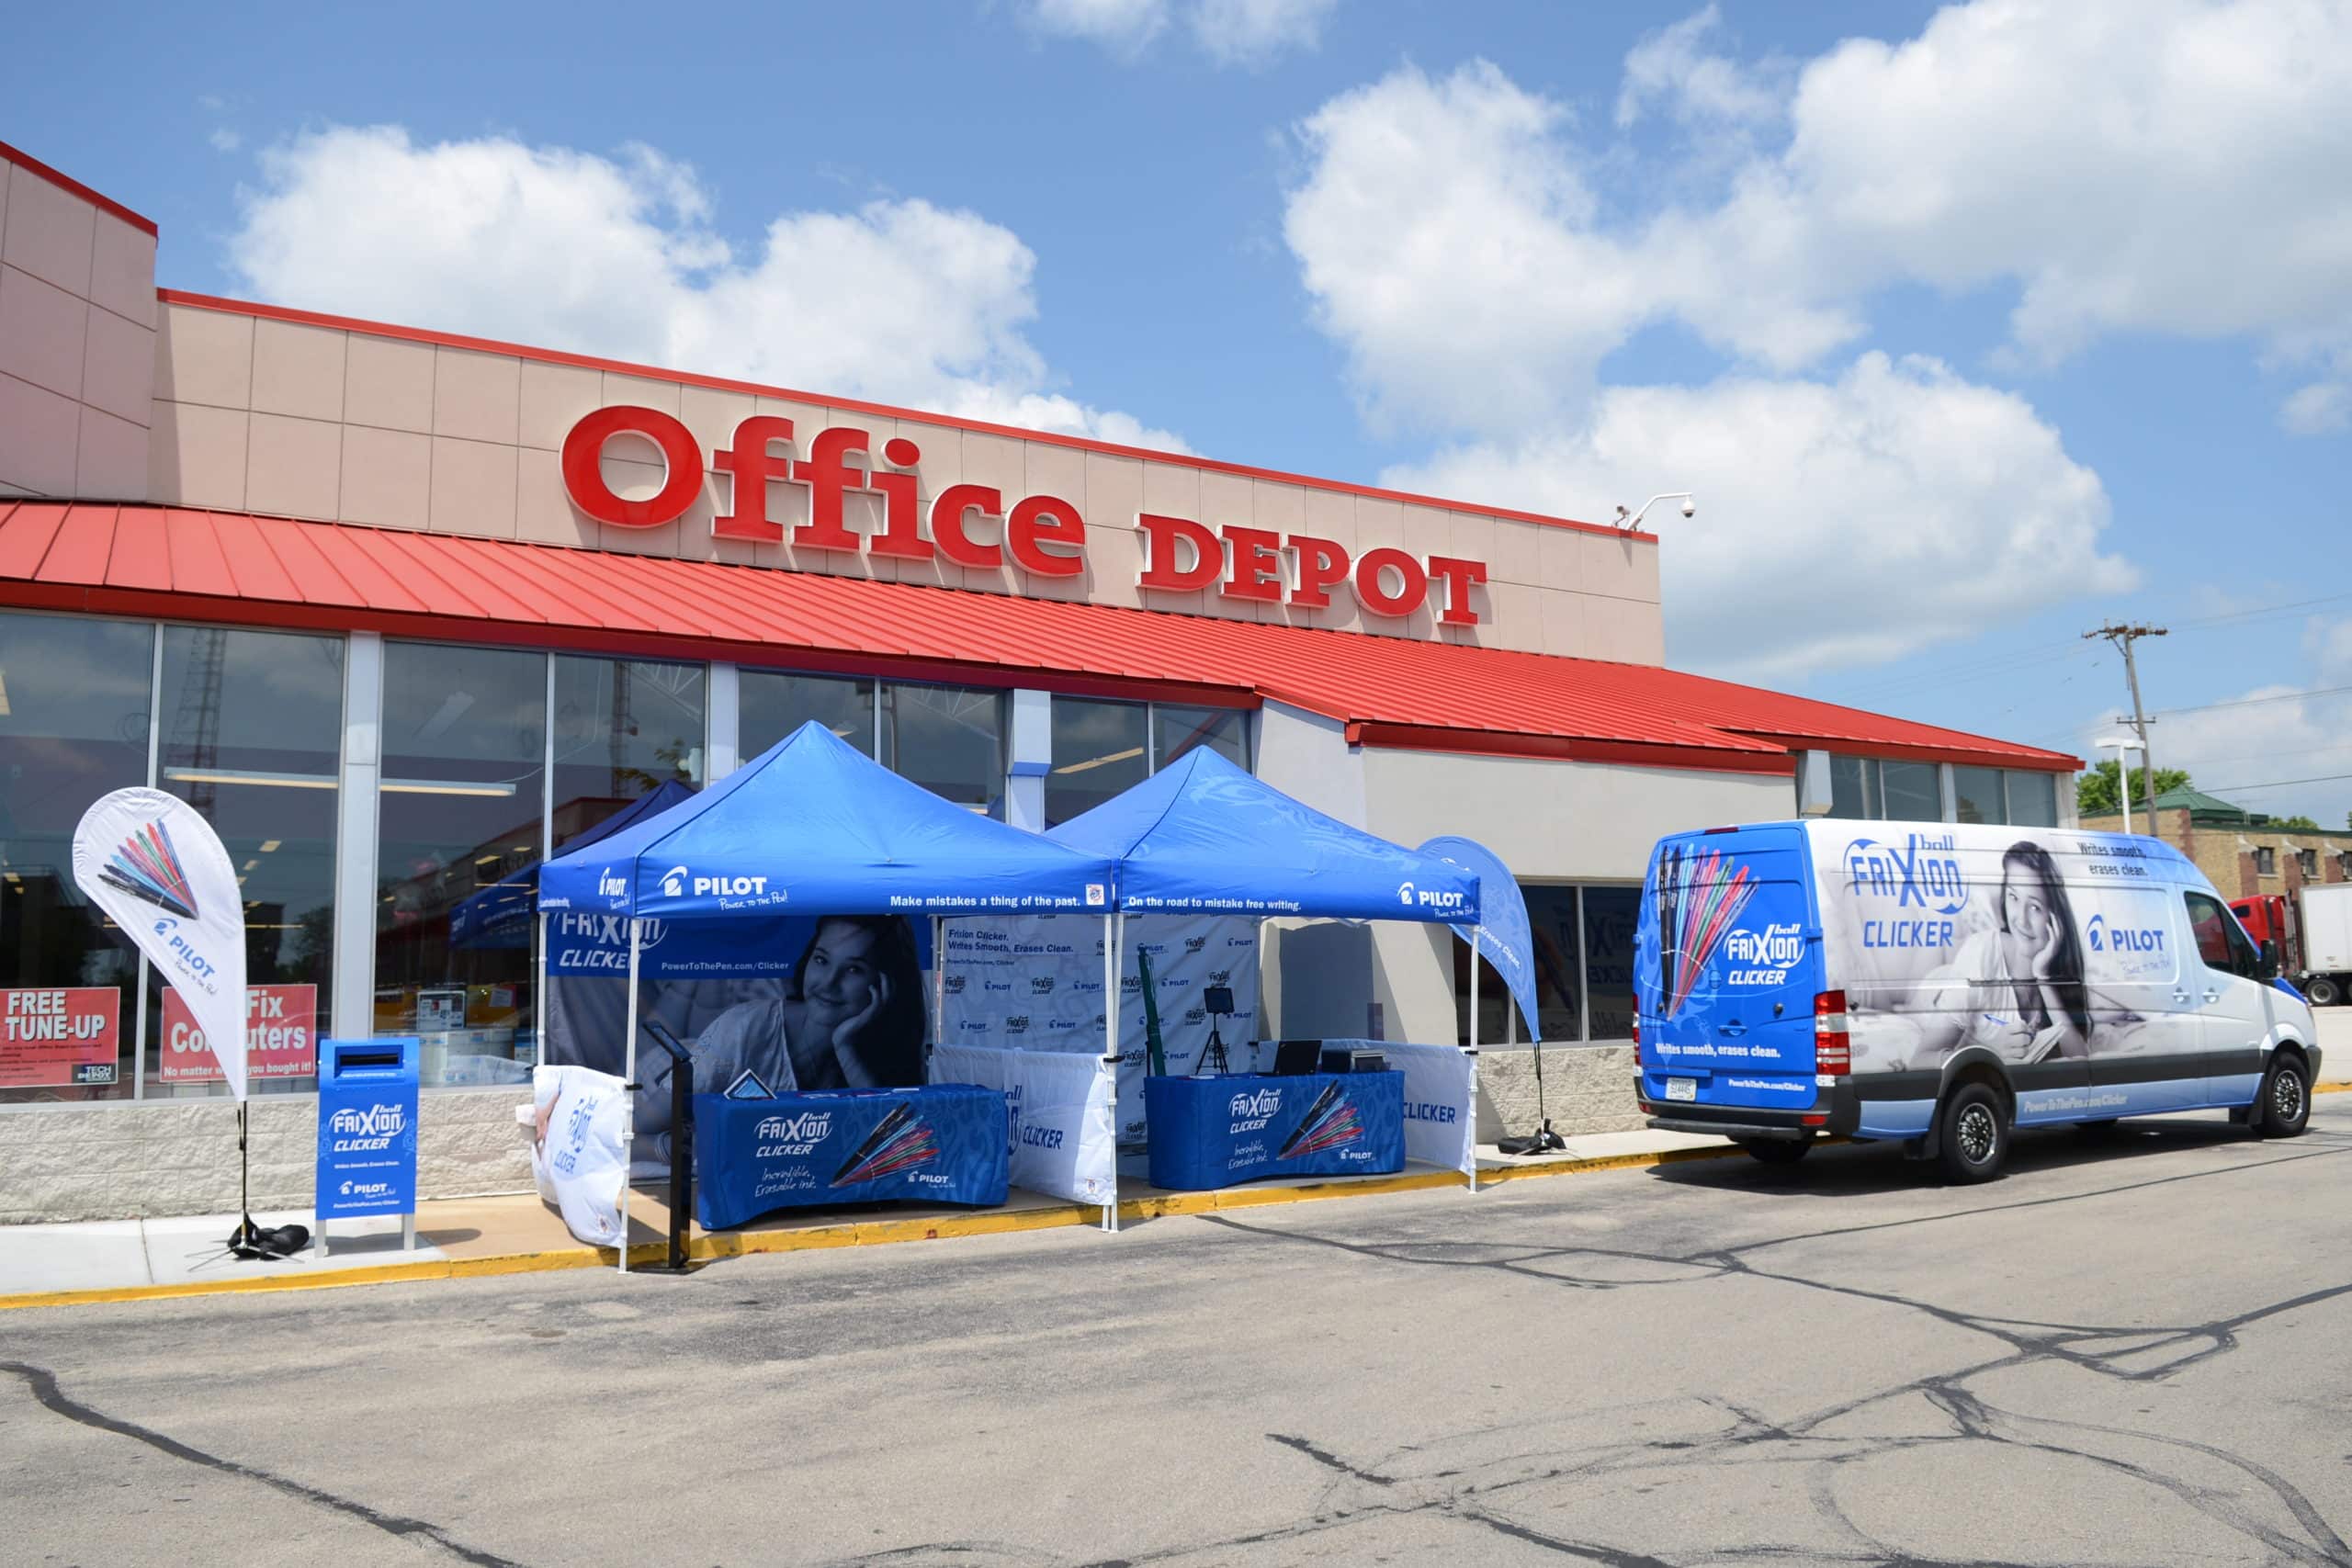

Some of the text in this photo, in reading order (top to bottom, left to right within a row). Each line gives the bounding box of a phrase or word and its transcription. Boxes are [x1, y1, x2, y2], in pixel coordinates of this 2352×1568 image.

[561, 405, 1487, 626] Office DEPOT
[1920, 834, 1954, 851] ball
[2077, 842, 2109, 855] Writes
[2088, 863, 2148, 875] erases clean.
[605, 878, 627, 897] PILOT
[694, 877, 767, 896] PILOT
[890, 896, 1081, 909] Make mistakes a thing of the past.
[1128, 897, 1302, 911] On the road to mistake free writing.
[1419, 891, 1463, 908] PILOT
[1774, 924, 1801, 934] ball
[1863, 921, 1953, 947] CLICKER
[1480, 925, 1502, 949] Erases
[2111, 930, 2164, 951] PILOT
[948, 941, 1074, 953] Writes Smooth, Erases Clean.
[169, 935, 215, 977] PILOT
[559, 950, 641, 969] CLICKE
[662, 961, 789, 971] PowerToThePen.com/Clicker
[1728, 970, 1786, 985] CLICKER
[7, 991, 66, 1014] FREE
[246, 989, 283, 1018] Fix
[6, 1015, 106, 1041] TUNE-UP
[171, 1021, 307, 1053] Couters
[1656, 1043, 1781, 1058] Writes smooth, erases clean.
[164, 1066, 177, 1077] No
[180, 1065, 212, 1076] matter
[248, 1062, 311, 1076] you bought it!
[379, 1104, 402, 1113] ball
[1403, 1101, 1456, 1124] CLICKER
[808, 1112, 831, 1121] ball
[1230, 1119, 1267, 1134] CLICKER
[1023, 1125, 1063, 1149] CLICKER
[334, 1138, 390, 1152] CLICKER
[756, 1145, 814, 1157] CLICKER
[919, 1175, 948, 1183] PILOT
[354, 1183, 388, 1193] PILOT
[754, 1178, 797, 1198] Erasable
